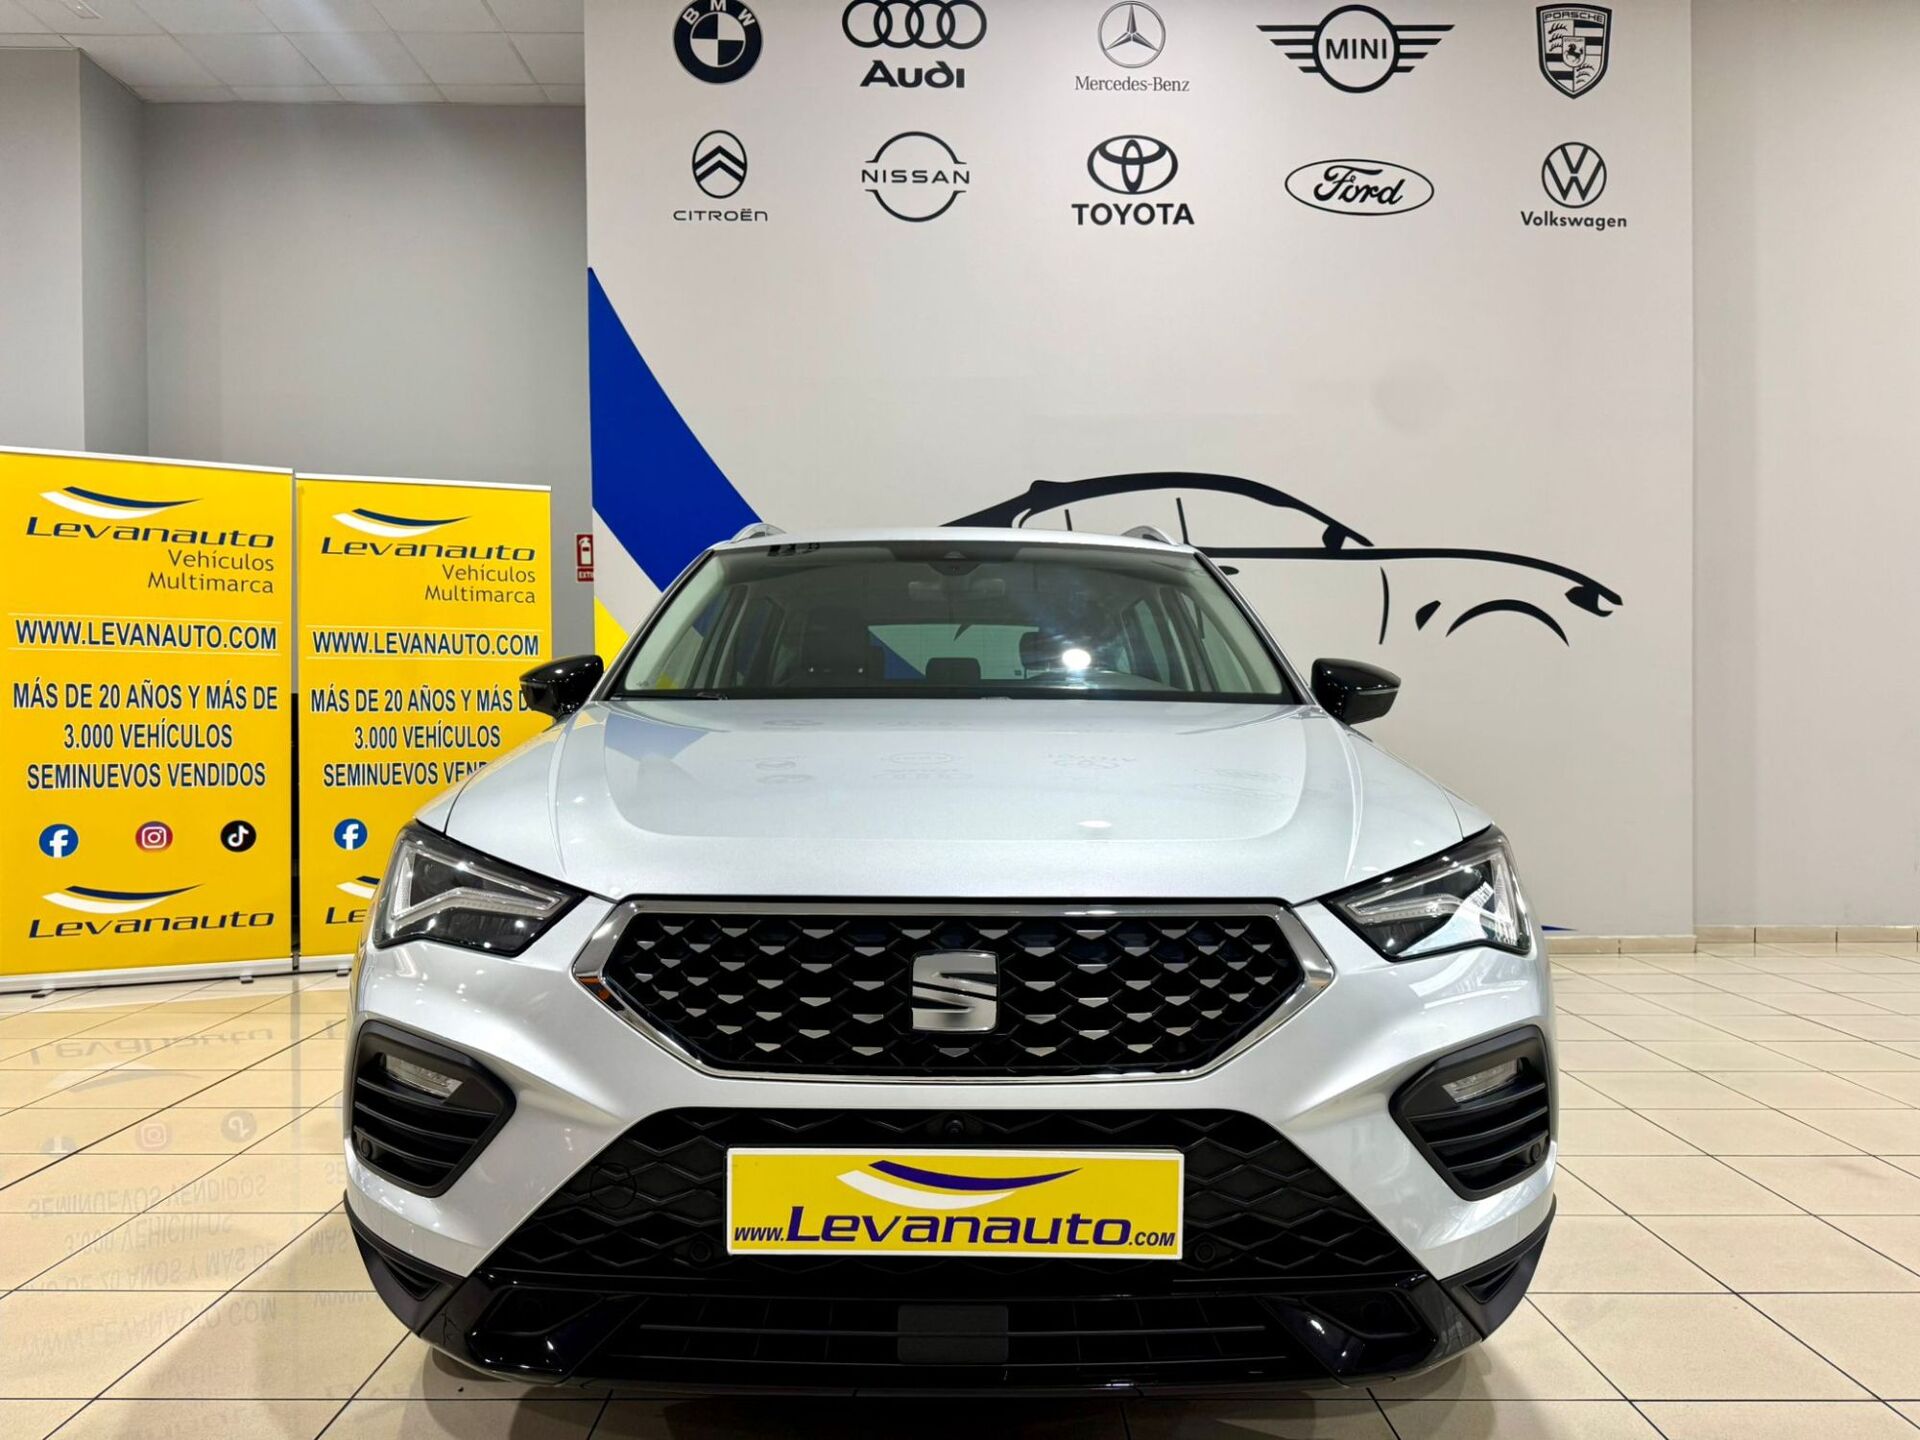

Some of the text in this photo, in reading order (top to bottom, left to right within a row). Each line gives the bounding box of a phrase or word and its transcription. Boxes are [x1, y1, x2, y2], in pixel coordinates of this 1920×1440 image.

[682, 0, 755, 27] BMW
[1544, 11, 1603, 22] PORSCHE
[1325, 38, 1387, 60] MINI
[860, 60, 965, 88] Audi
[1075, 75, 1190, 92] Mercedes-Benz
[861, 169, 970, 184] NISSAN
[1313, 164, 1405, 205] Ford
[1071, 203, 1195, 225] TOYOTA
[1520, 211, 1627, 231] Volkswagen
[27, 516, 274, 548] Levanauto
[168, 549, 274, 572] Vehículos
[321, 537, 535, 561] Levanauto
[148, 571, 274, 594] Multimarca
[441, 564, 536, 583] Vehículos
[424, 584, 536, 604] Multimarca
[16, 619, 277, 650] WWW.LEVANAUTO.COM
[312, 631, 539, 656] WWW.LEVANAUTO.COM
[13, 677, 278, 710] MÁS DE 20 AÑOS Y MÁS DE
[311, 683, 350, 712] MÁS
[355, 688, 379, 712] DE
[384, 689, 403, 712] 20
[407, 684, 456, 712] AÑOS
[460, 689, 472, 712] Y
[476, 684, 513, 712] MÁS
[63, 717, 233, 749] 3.000 VEHÍCULOS
[354, 720, 501, 750] 3.000 VEHÍCULOS
[27, 762, 266, 790] SEMINUEVOS VENDIDOS
[323, 761, 439, 788] SEMINUEVOS
[28, 911, 275, 939] Levanauto
